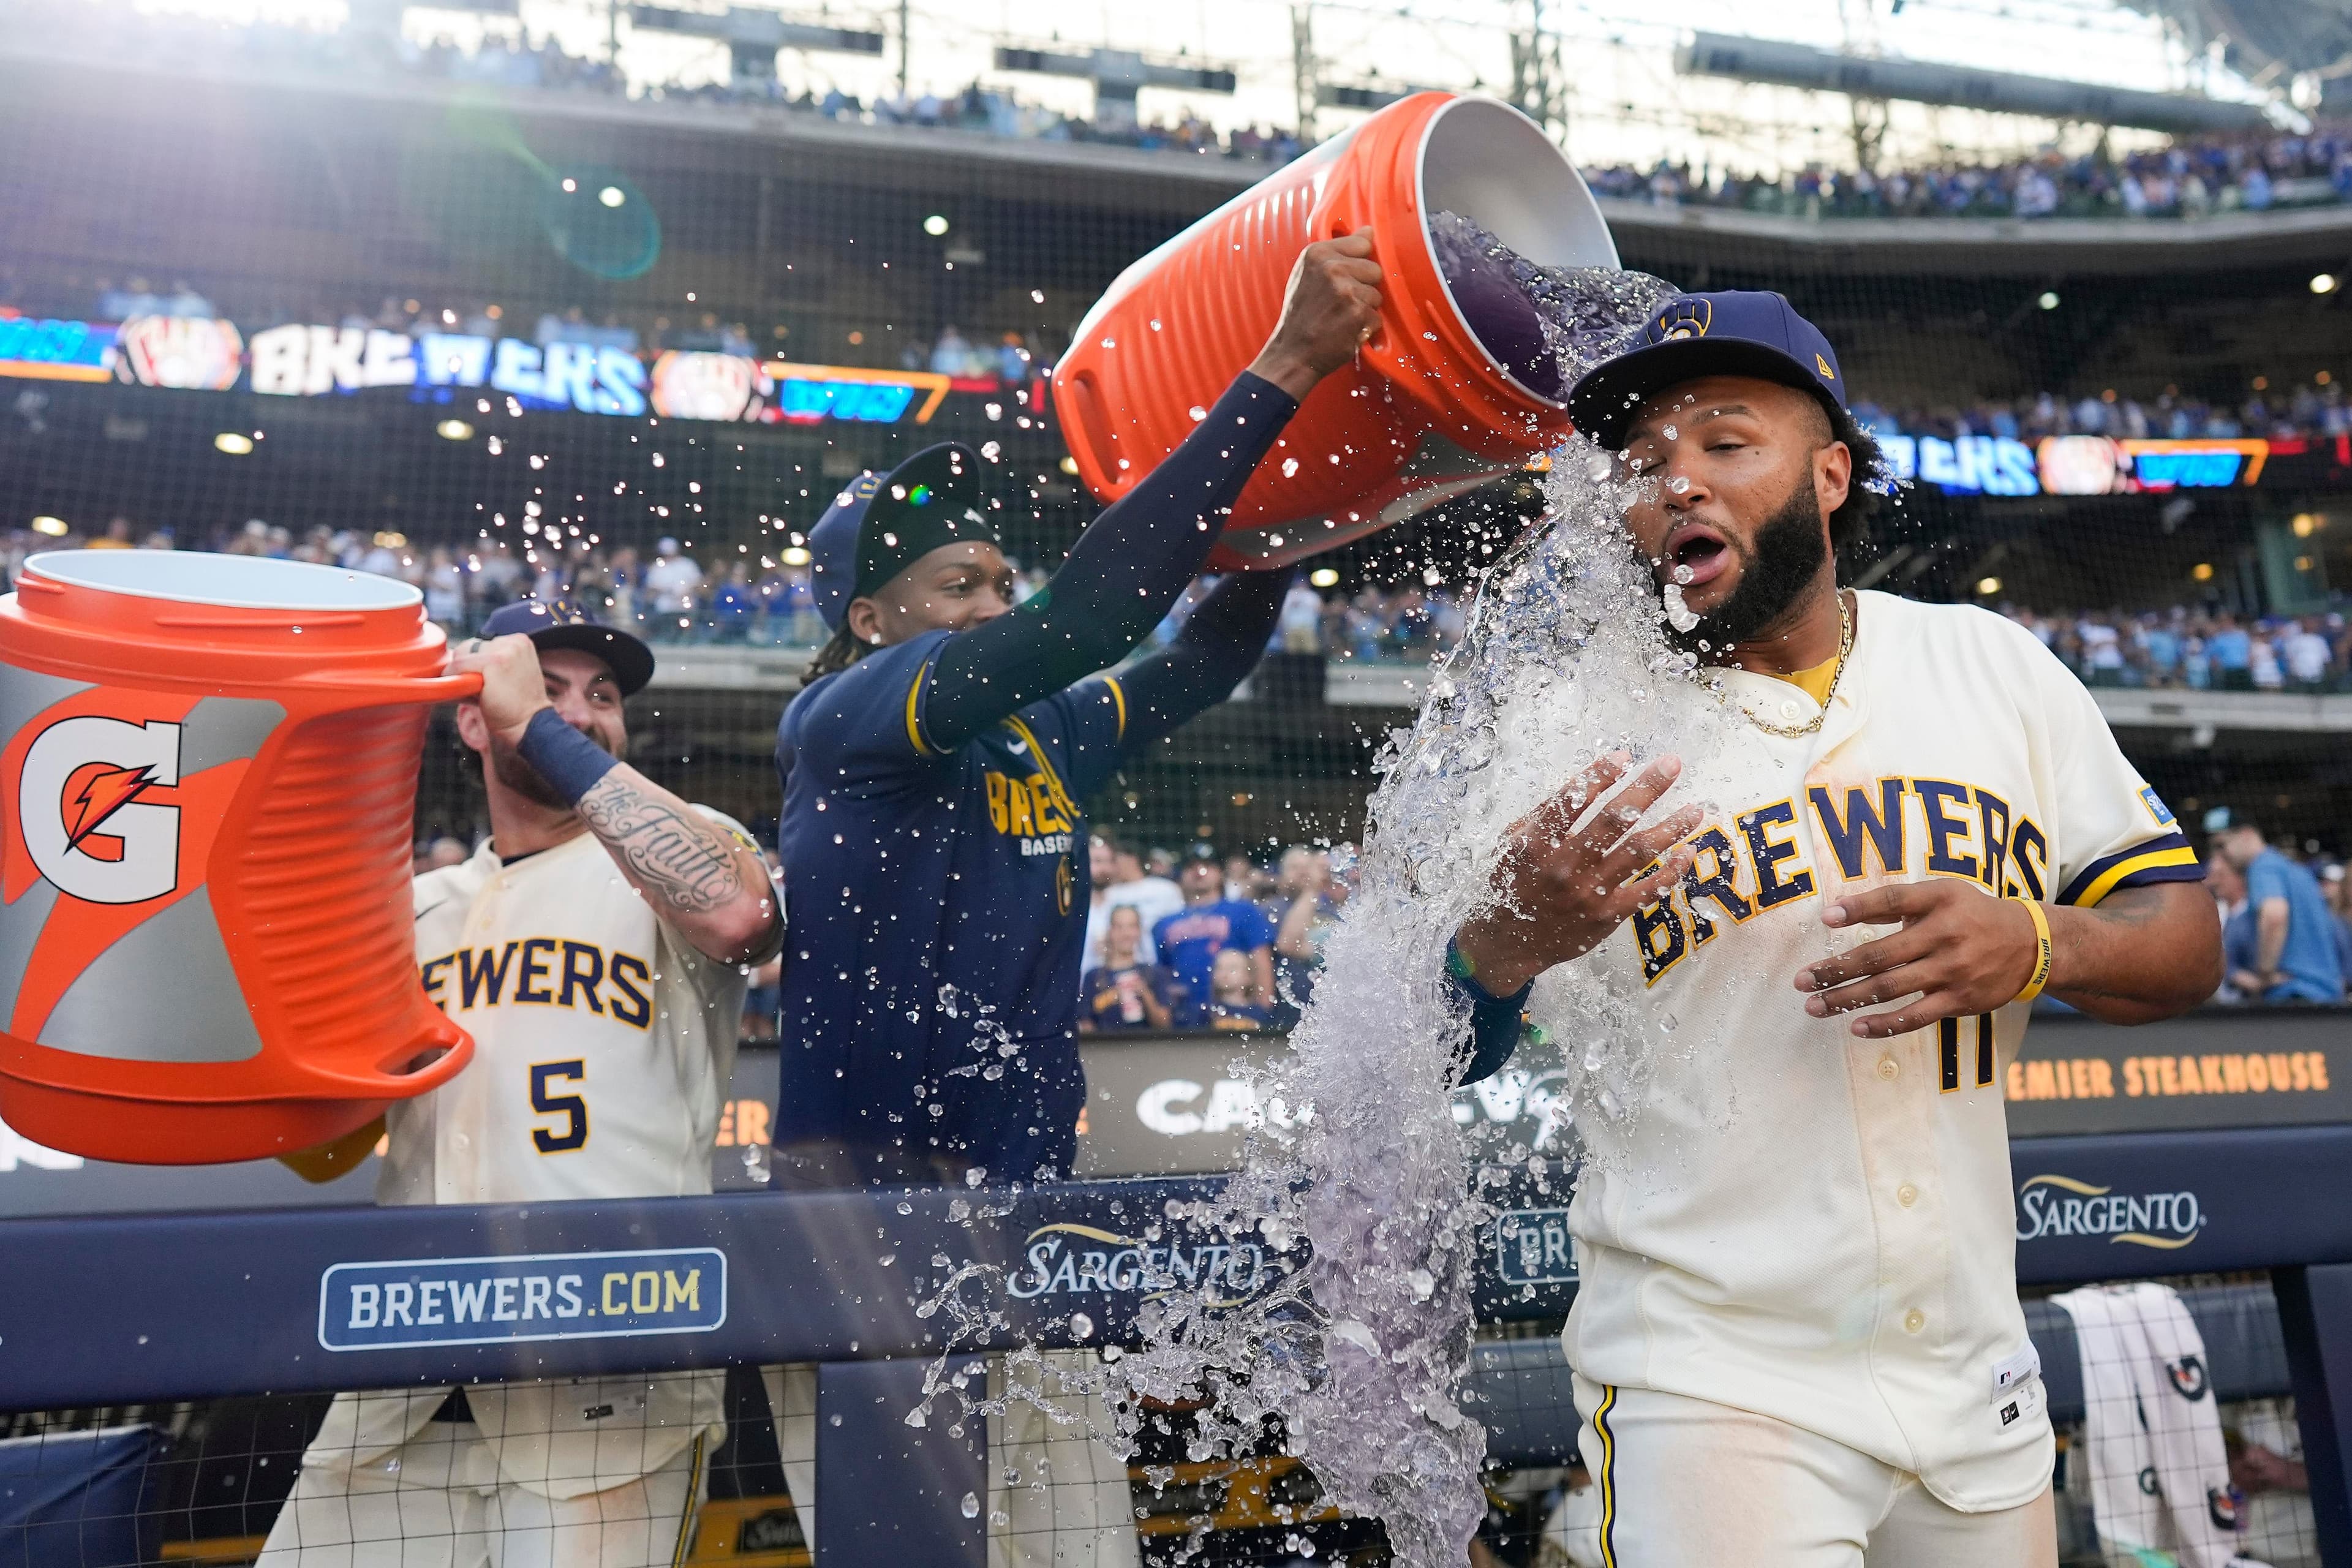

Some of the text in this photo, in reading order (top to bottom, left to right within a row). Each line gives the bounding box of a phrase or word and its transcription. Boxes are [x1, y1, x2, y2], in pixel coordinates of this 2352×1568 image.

[19, 715, 181, 904] G
[1629, 775, 2048, 990] BREWERS
[2032, 938, 2051, 985] BREWERS
[2123, 1051, 2328, 1098] STEAKHOUSE
[529, 1058, 590, 1156] 5
[2016, 1188, 2199, 1241] SARGENTO
[1006, 1238, 1264, 1298] SARGENTO
[348, 1268, 701, 1329] BREWERS.COM
